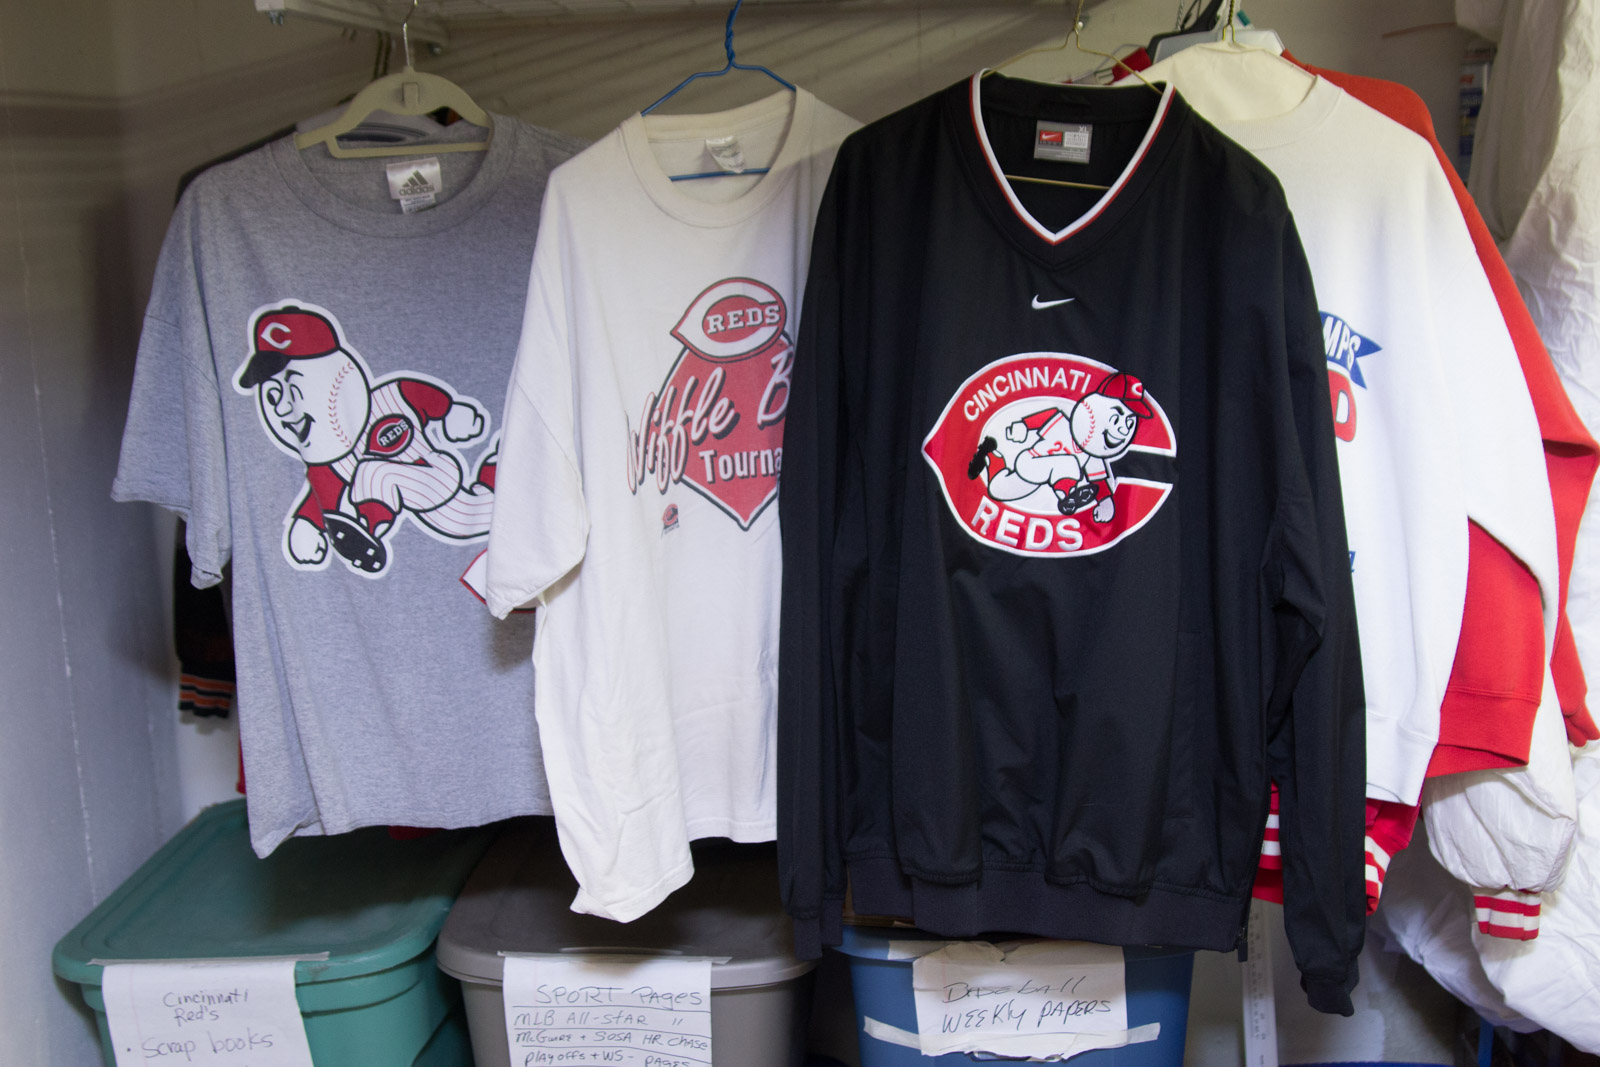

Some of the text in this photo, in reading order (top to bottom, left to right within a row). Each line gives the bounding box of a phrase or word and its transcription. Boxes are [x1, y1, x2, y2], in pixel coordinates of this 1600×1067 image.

[399, 183, 435, 196] adidas
[706, 304, 782, 335] REDS
[260, 321, 292, 350] C
[963, 366, 1092, 422] CINCINNATI
[379, 419, 409, 446] REDS
[971, 495, 1084, 551] REDS
[162, 988, 249, 1008] Cincinnati
[536, 984, 625, 1004] SPORT
[174, 1005, 220, 1027] Red's
[141, 1027, 274, 1062] Scrap books
[593, 1031, 633, 1043] SOSA
[643, 1033, 664, 1046] HR
[602, 1049, 625, 1062] WS
